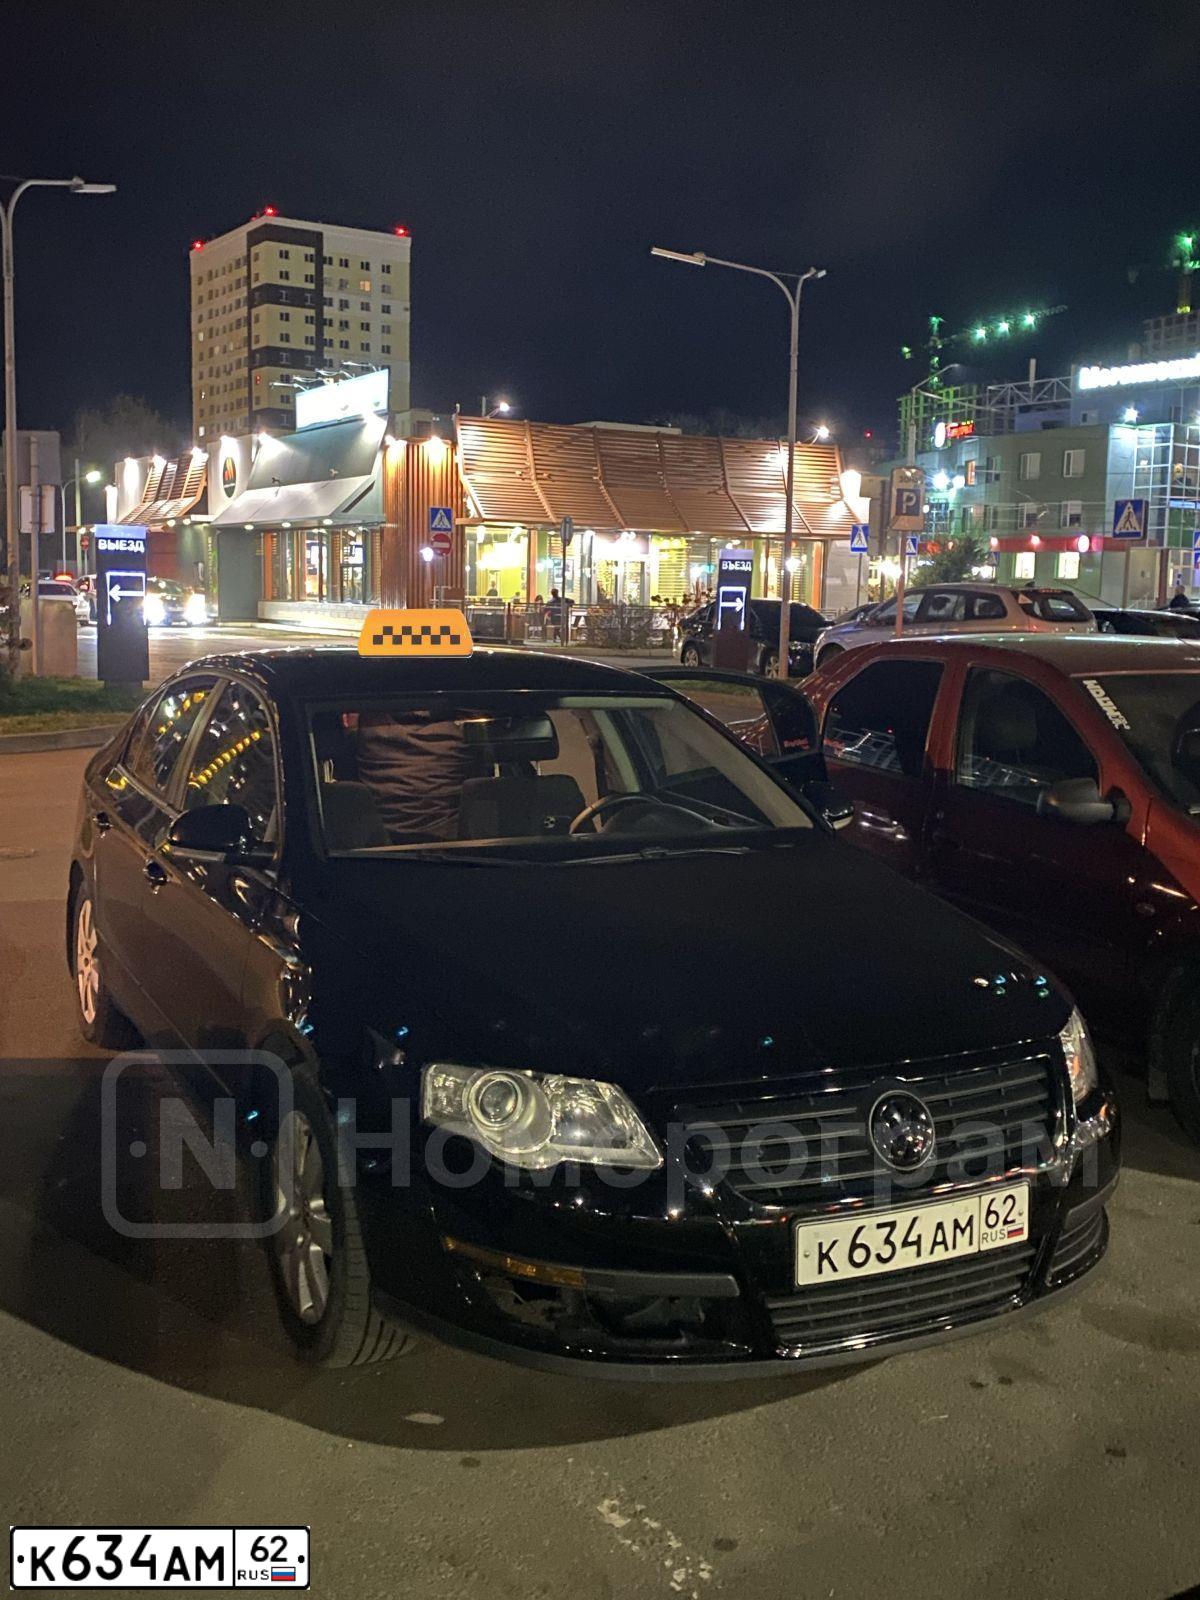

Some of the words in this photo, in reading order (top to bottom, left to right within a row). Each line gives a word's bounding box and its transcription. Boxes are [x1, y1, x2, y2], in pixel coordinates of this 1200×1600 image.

[902, 491, 917, 514] P
[98, 538, 145, 553] ВЫЕЗД
[721, 560, 752, 571] ВЪЕЗД
[984, 1194, 1017, 1230] 62
[981, 1228, 1006, 1244] RUS
